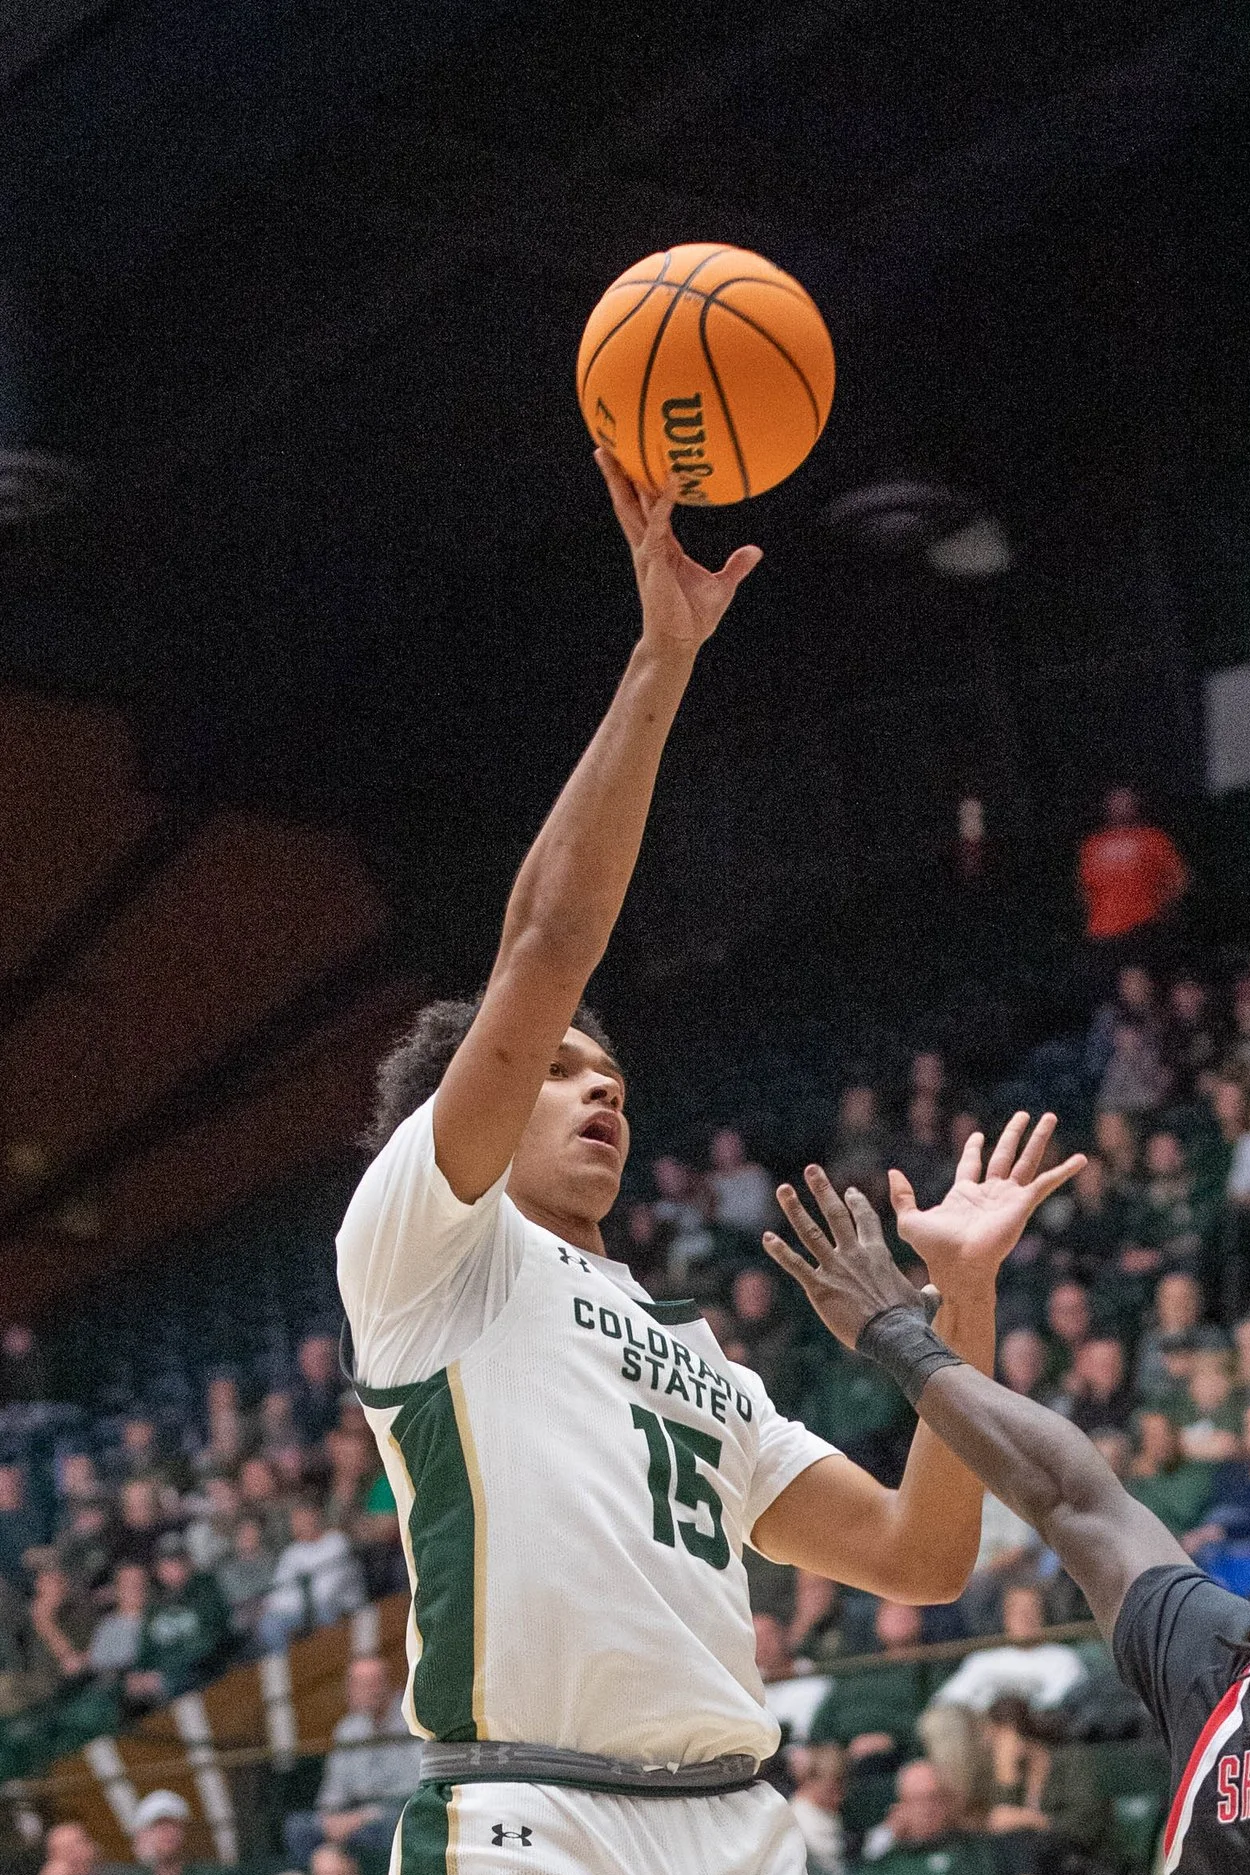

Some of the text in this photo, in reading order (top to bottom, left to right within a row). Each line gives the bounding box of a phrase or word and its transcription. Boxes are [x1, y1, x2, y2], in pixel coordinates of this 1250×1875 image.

[662, 391, 714, 501] Wils
[621, 1347, 727, 1424] STATE
[629, 1402, 731, 1570] 15
